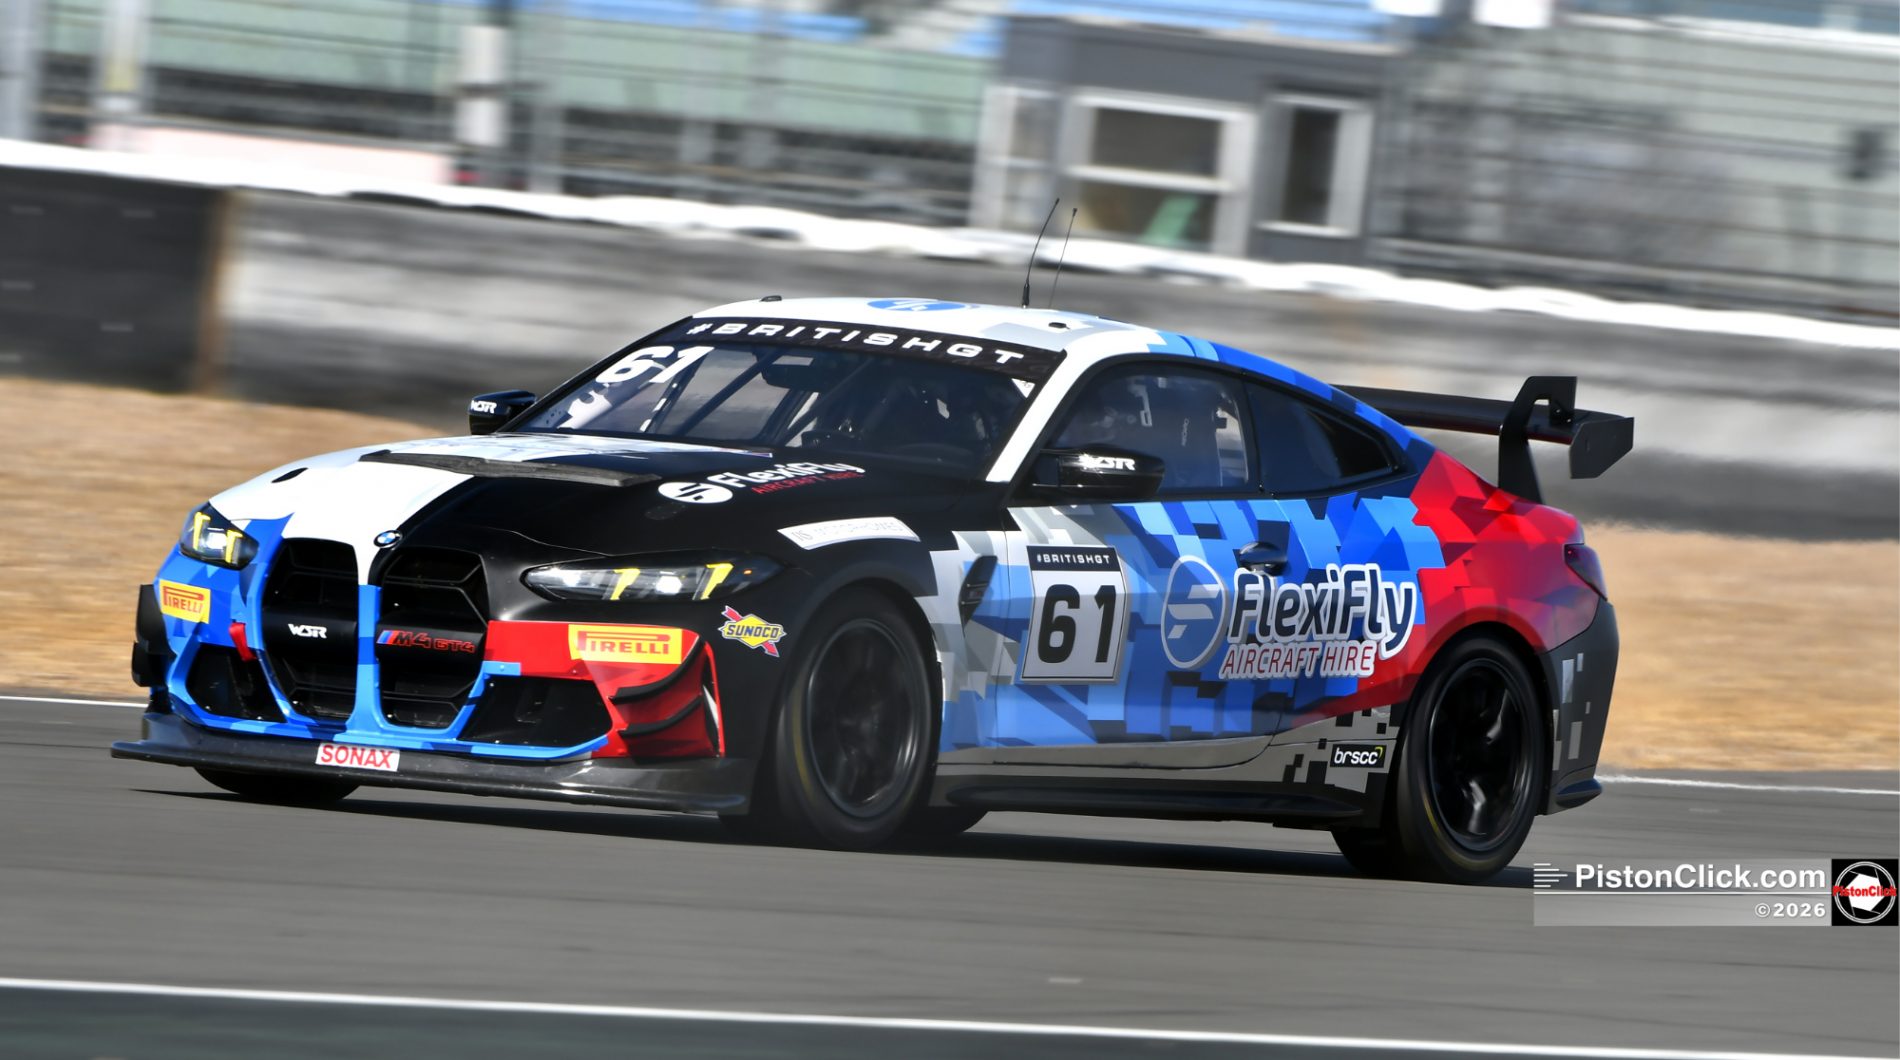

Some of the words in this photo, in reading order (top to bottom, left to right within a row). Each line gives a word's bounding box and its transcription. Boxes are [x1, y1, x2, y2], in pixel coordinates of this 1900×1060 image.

[686, 322, 1024, 365] #BRITISHGT
[596, 346, 715, 383] 61
[1036, 553, 1110, 565] #BRITISHGT
[162, 586, 204, 613] PIRELLI
[1230, 568, 1413, 653] FlexiFly
[727, 622, 781, 640] SUNOCO
[1037, 584, 1118, 664] 61
[434, 638, 475, 653] GT4
[577, 631, 672, 655] PIRELLI
[1222, 647, 1320, 674] AIRCRAFT
[1322, 646, 1374, 672] HIRE
[320, 744, 394, 769] SONAX
[1334, 747, 1380, 765] brscc
